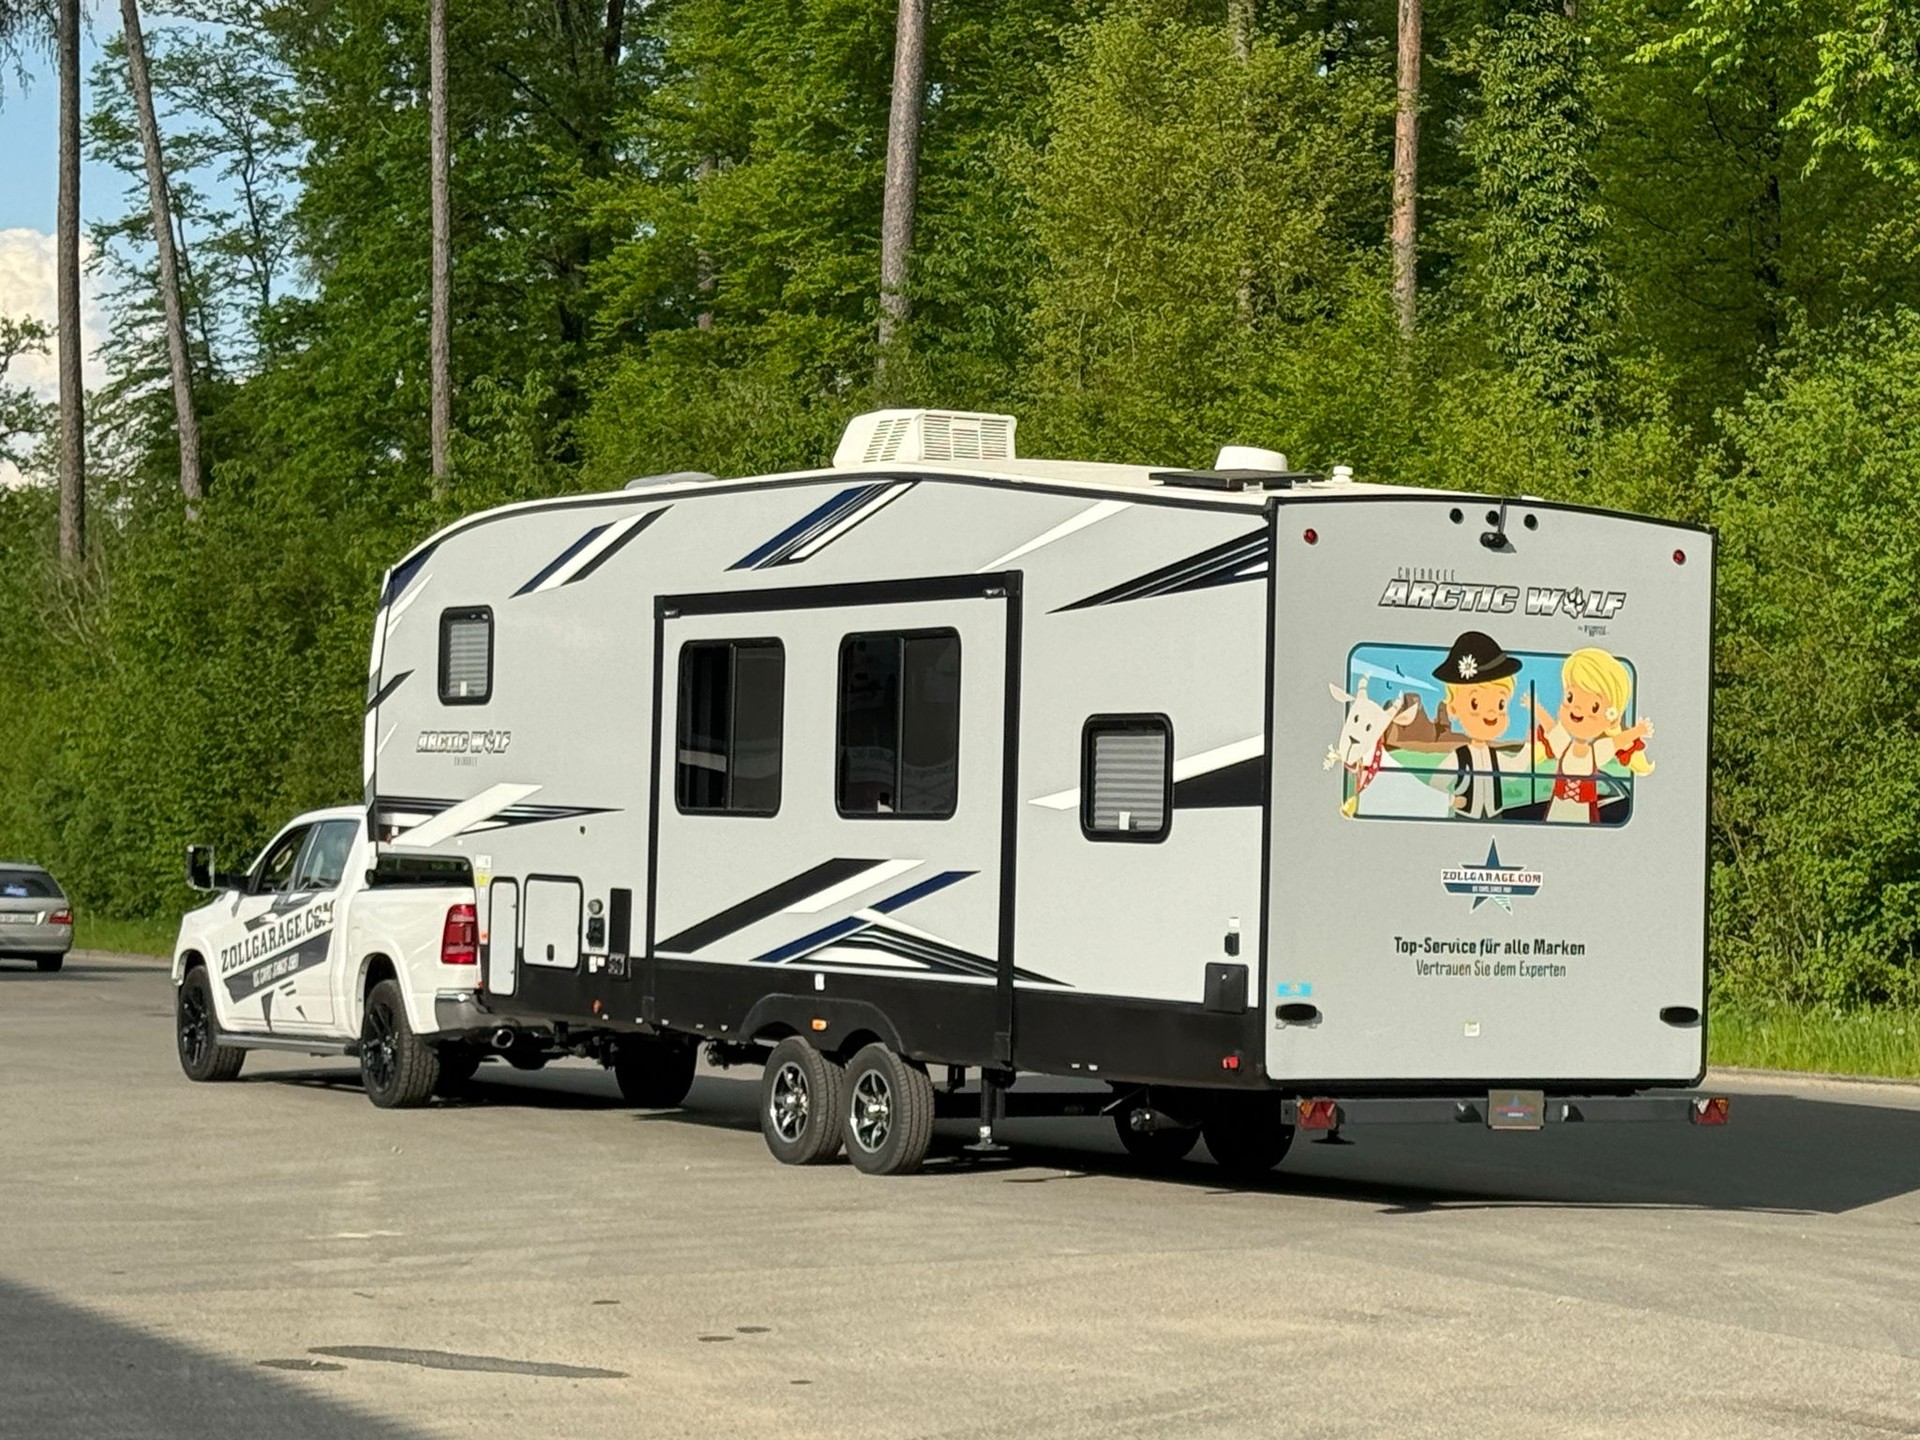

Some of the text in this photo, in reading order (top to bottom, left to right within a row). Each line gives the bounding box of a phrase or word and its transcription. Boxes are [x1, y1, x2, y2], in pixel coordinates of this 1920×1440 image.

[1378, 578, 1520, 614] ARCTIC
[416, 730, 469, 753] ARCTIC
[1442, 870, 1541, 883] ZOLLGARAGE.COM
[1394, 936, 1586, 957] Top-Service für alle Marken
[1416, 959, 1567, 979] Vertrauen Sie dem Experten
